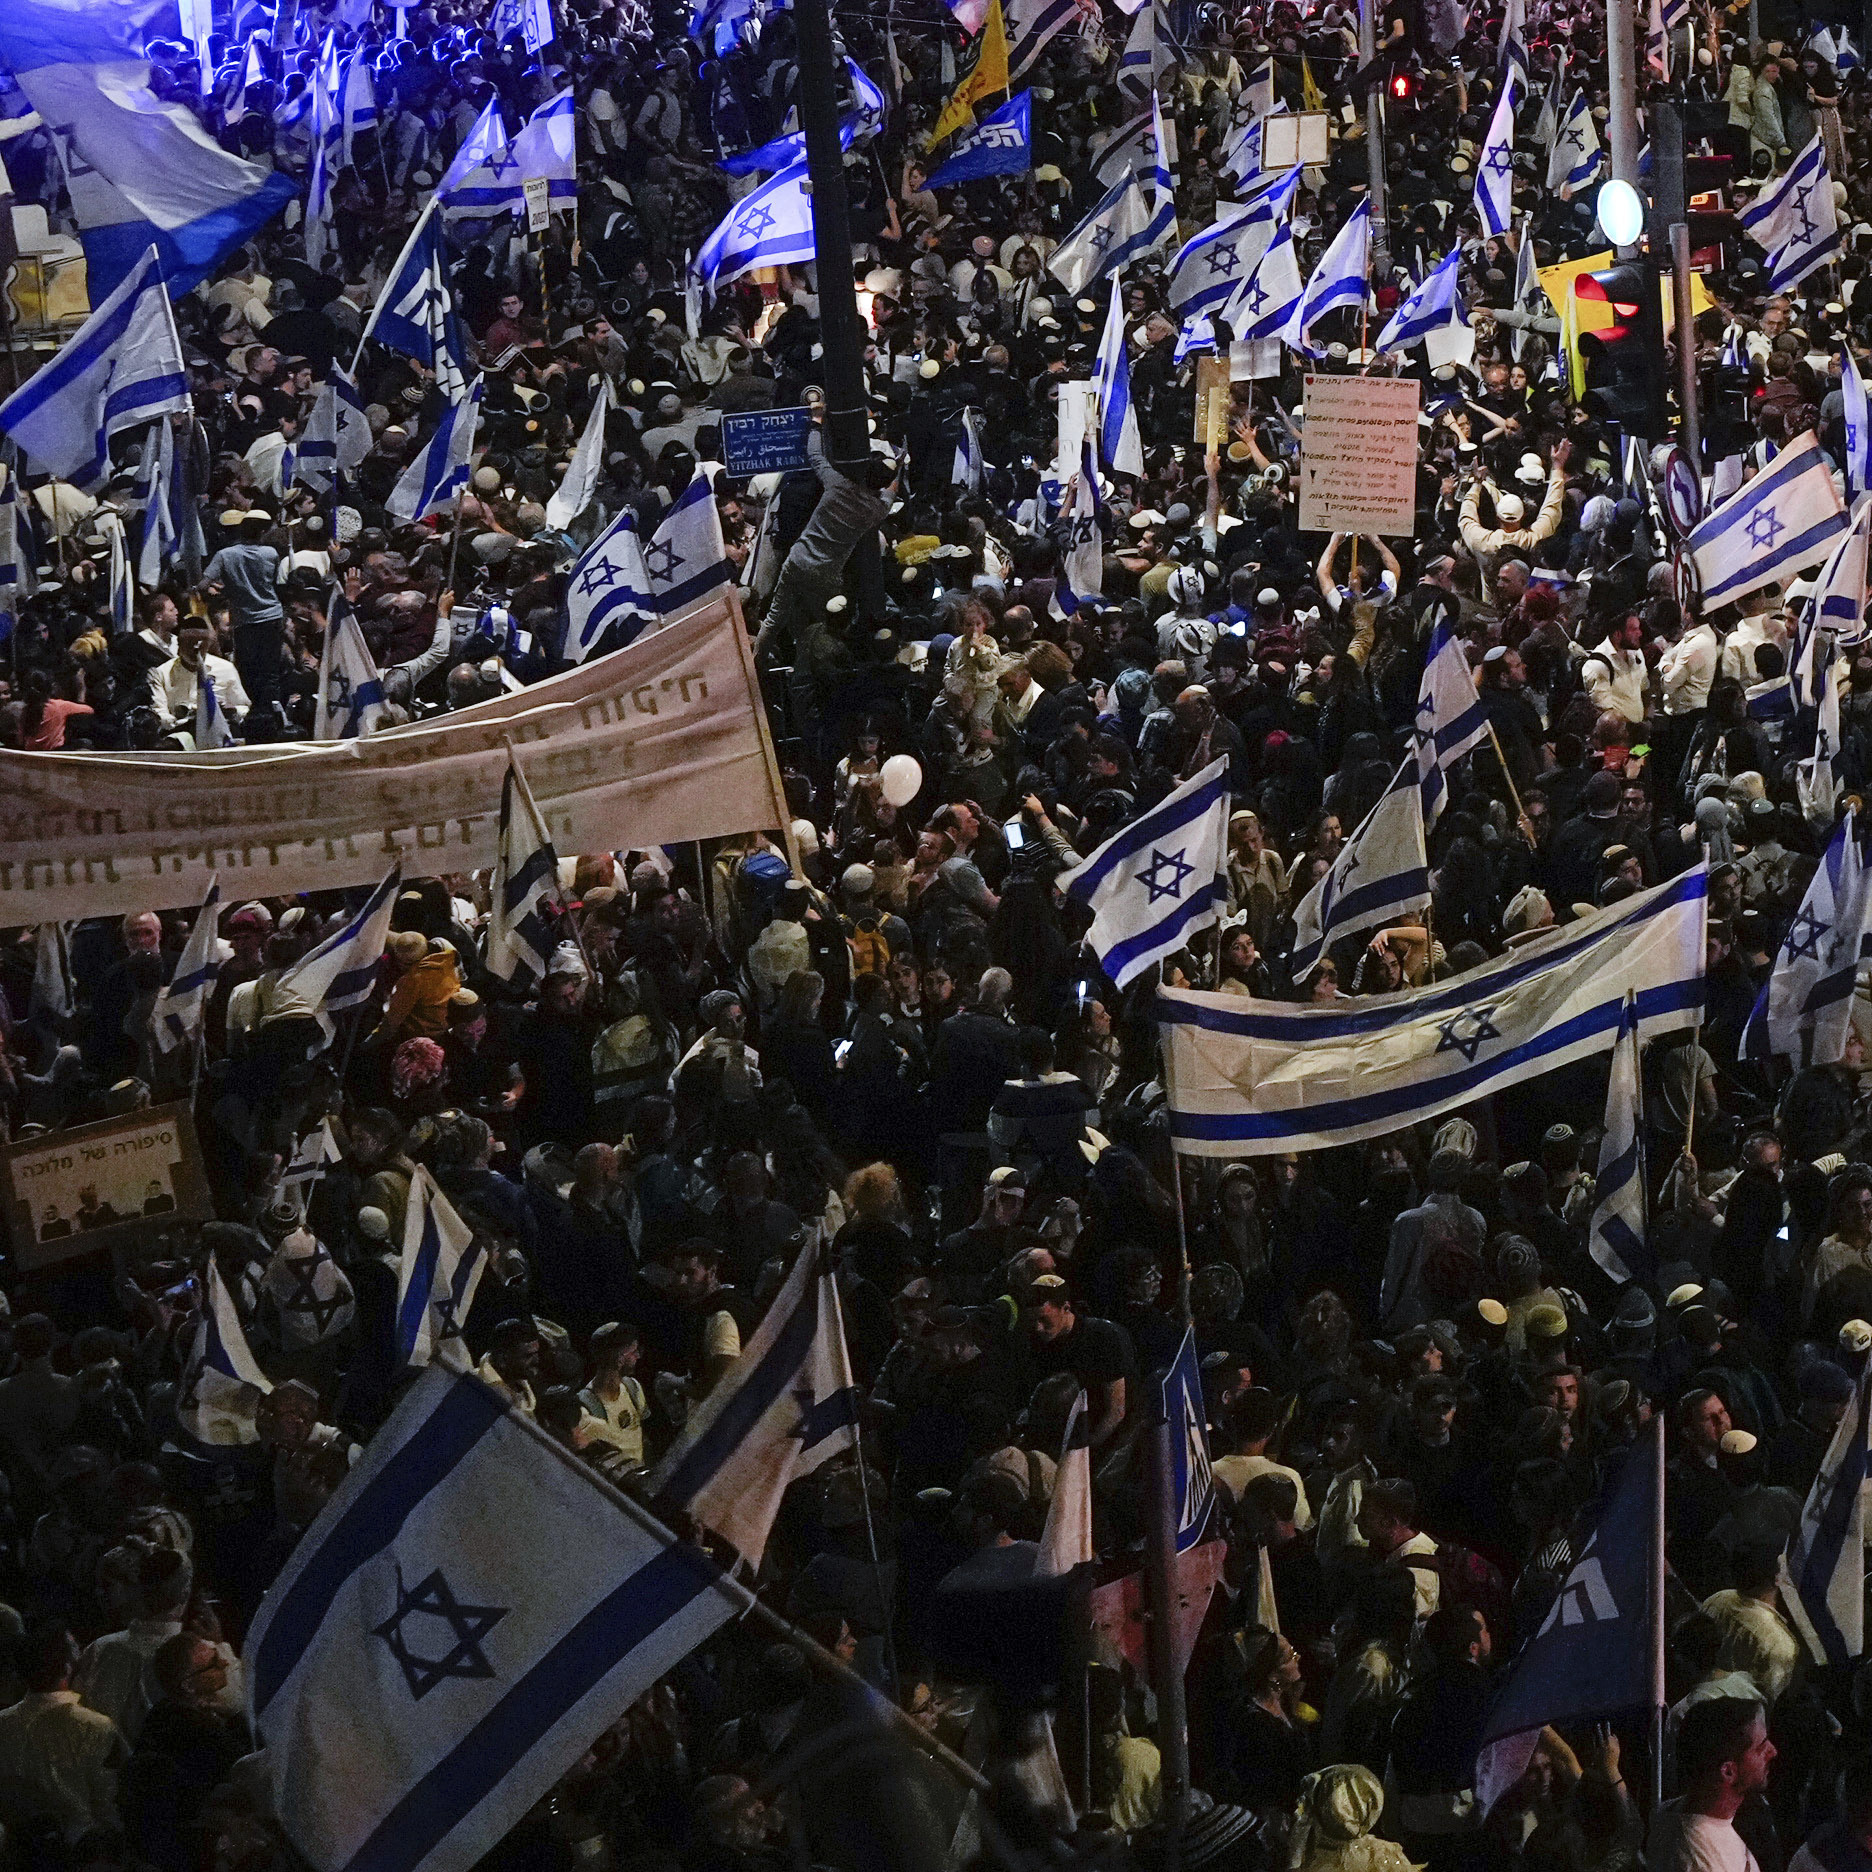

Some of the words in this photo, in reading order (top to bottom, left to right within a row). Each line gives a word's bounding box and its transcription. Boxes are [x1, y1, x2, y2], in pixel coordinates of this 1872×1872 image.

[949, 119, 1024, 160] הליכ
[727, 418, 755, 433] רבין
[761, 413, 795, 430] יצחק
[729, 457, 771, 471] YITZHAK
[776, 455, 805, 467] RABIN
[114, 1130, 175, 1158] סיפורה
[80, 1146, 109, 1162] של
[23, 1156, 74, 1179] מלוכה
